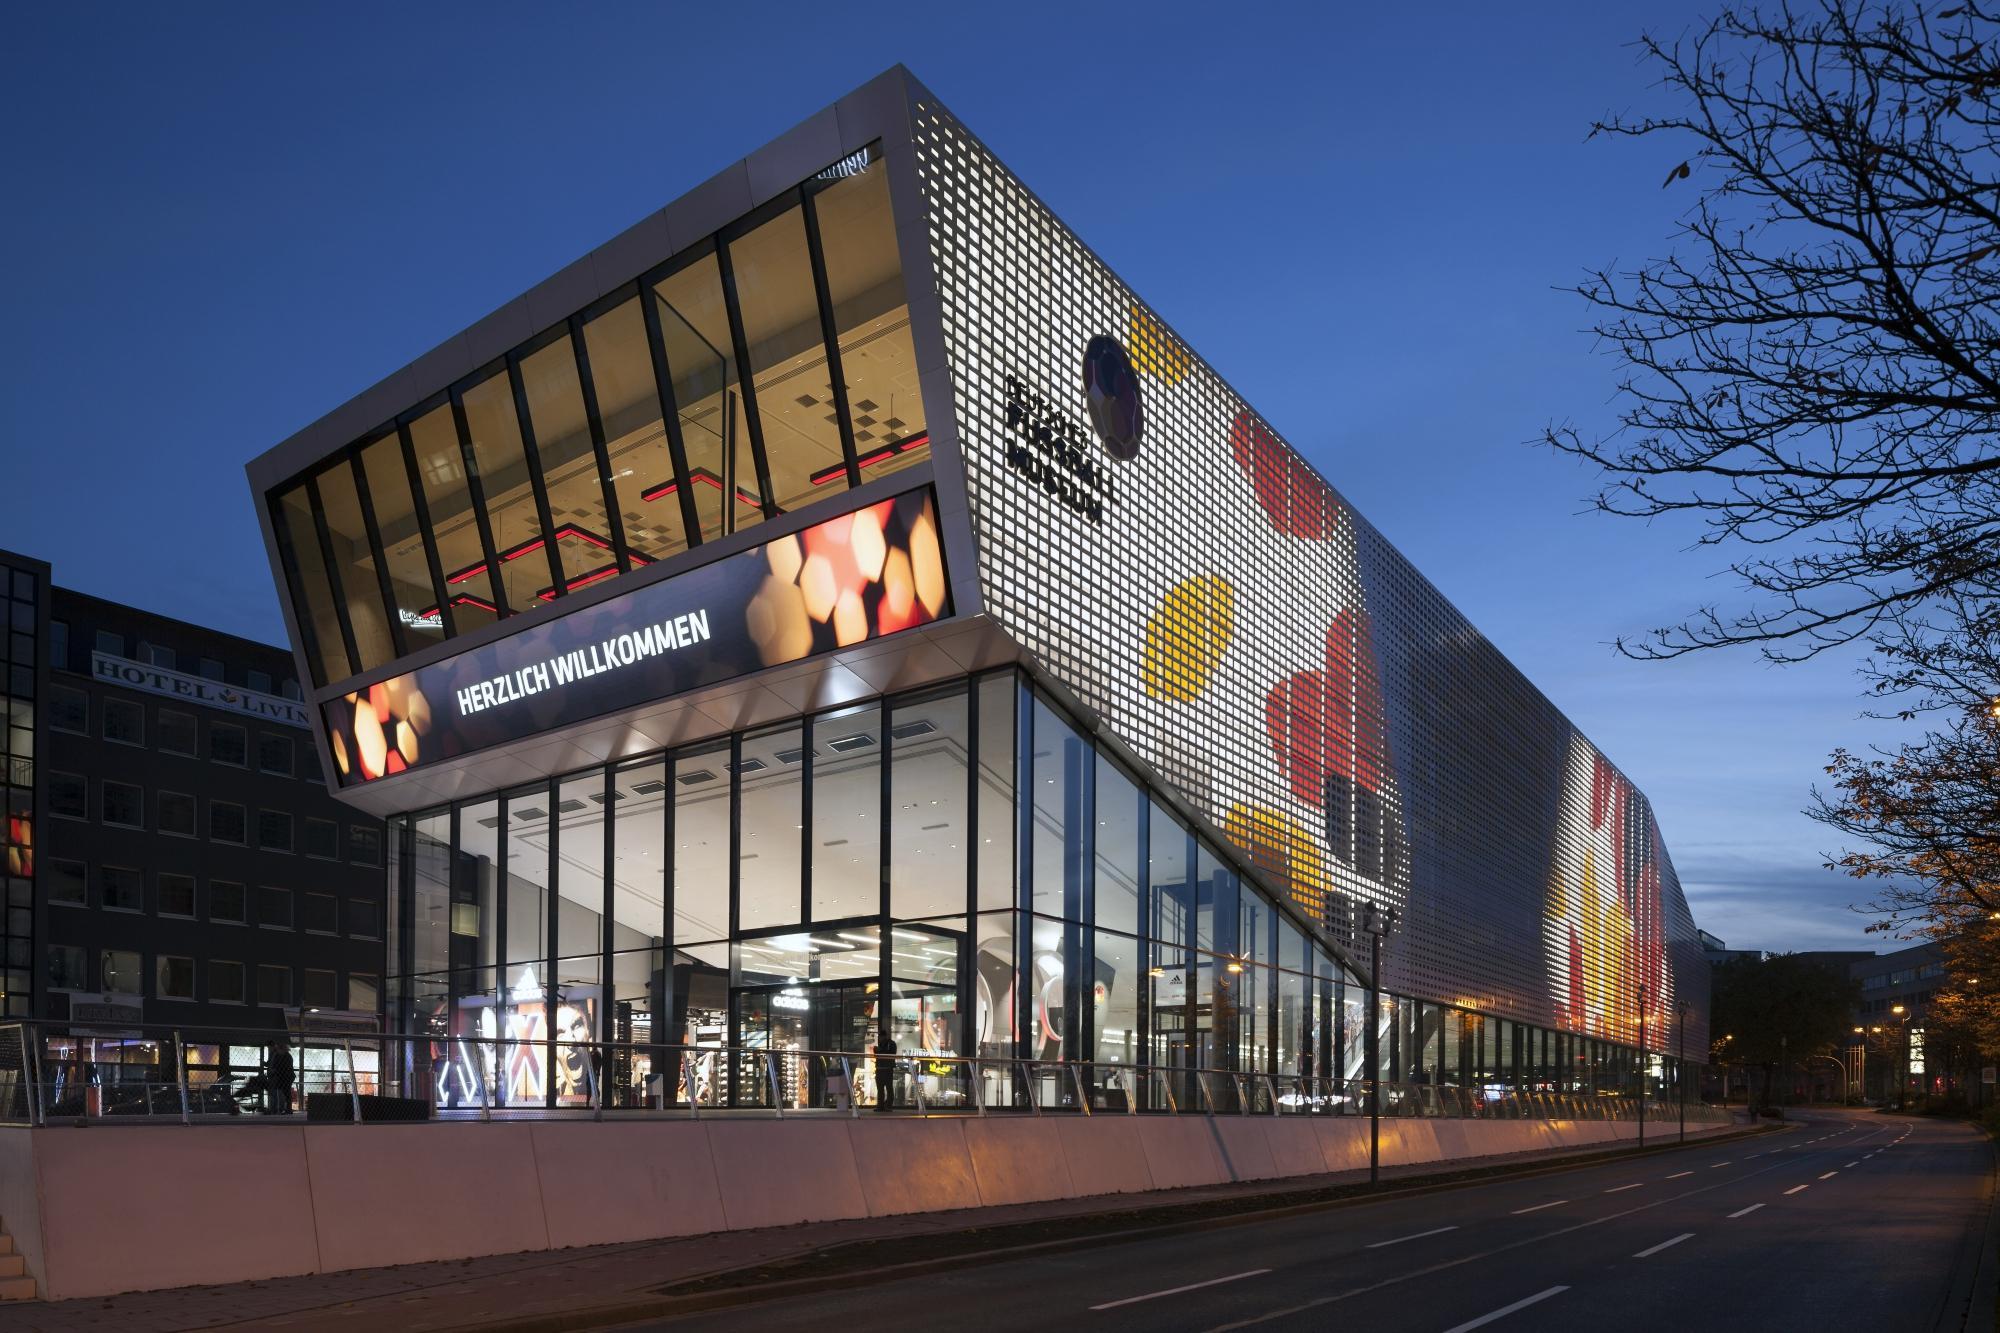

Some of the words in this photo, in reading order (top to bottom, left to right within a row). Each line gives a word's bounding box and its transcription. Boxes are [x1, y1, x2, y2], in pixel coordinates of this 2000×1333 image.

[1006, 400, 1120, 506] FUSSBALL
[1006, 437, 1103, 527] MUSEUM
[95, 660, 214, 701] HOTEL
[457, 662, 551, 716] HERZLICH
[550, 609, 711, 686] WILLKOMMEN
[772, 995, 810, 1010] adidas
